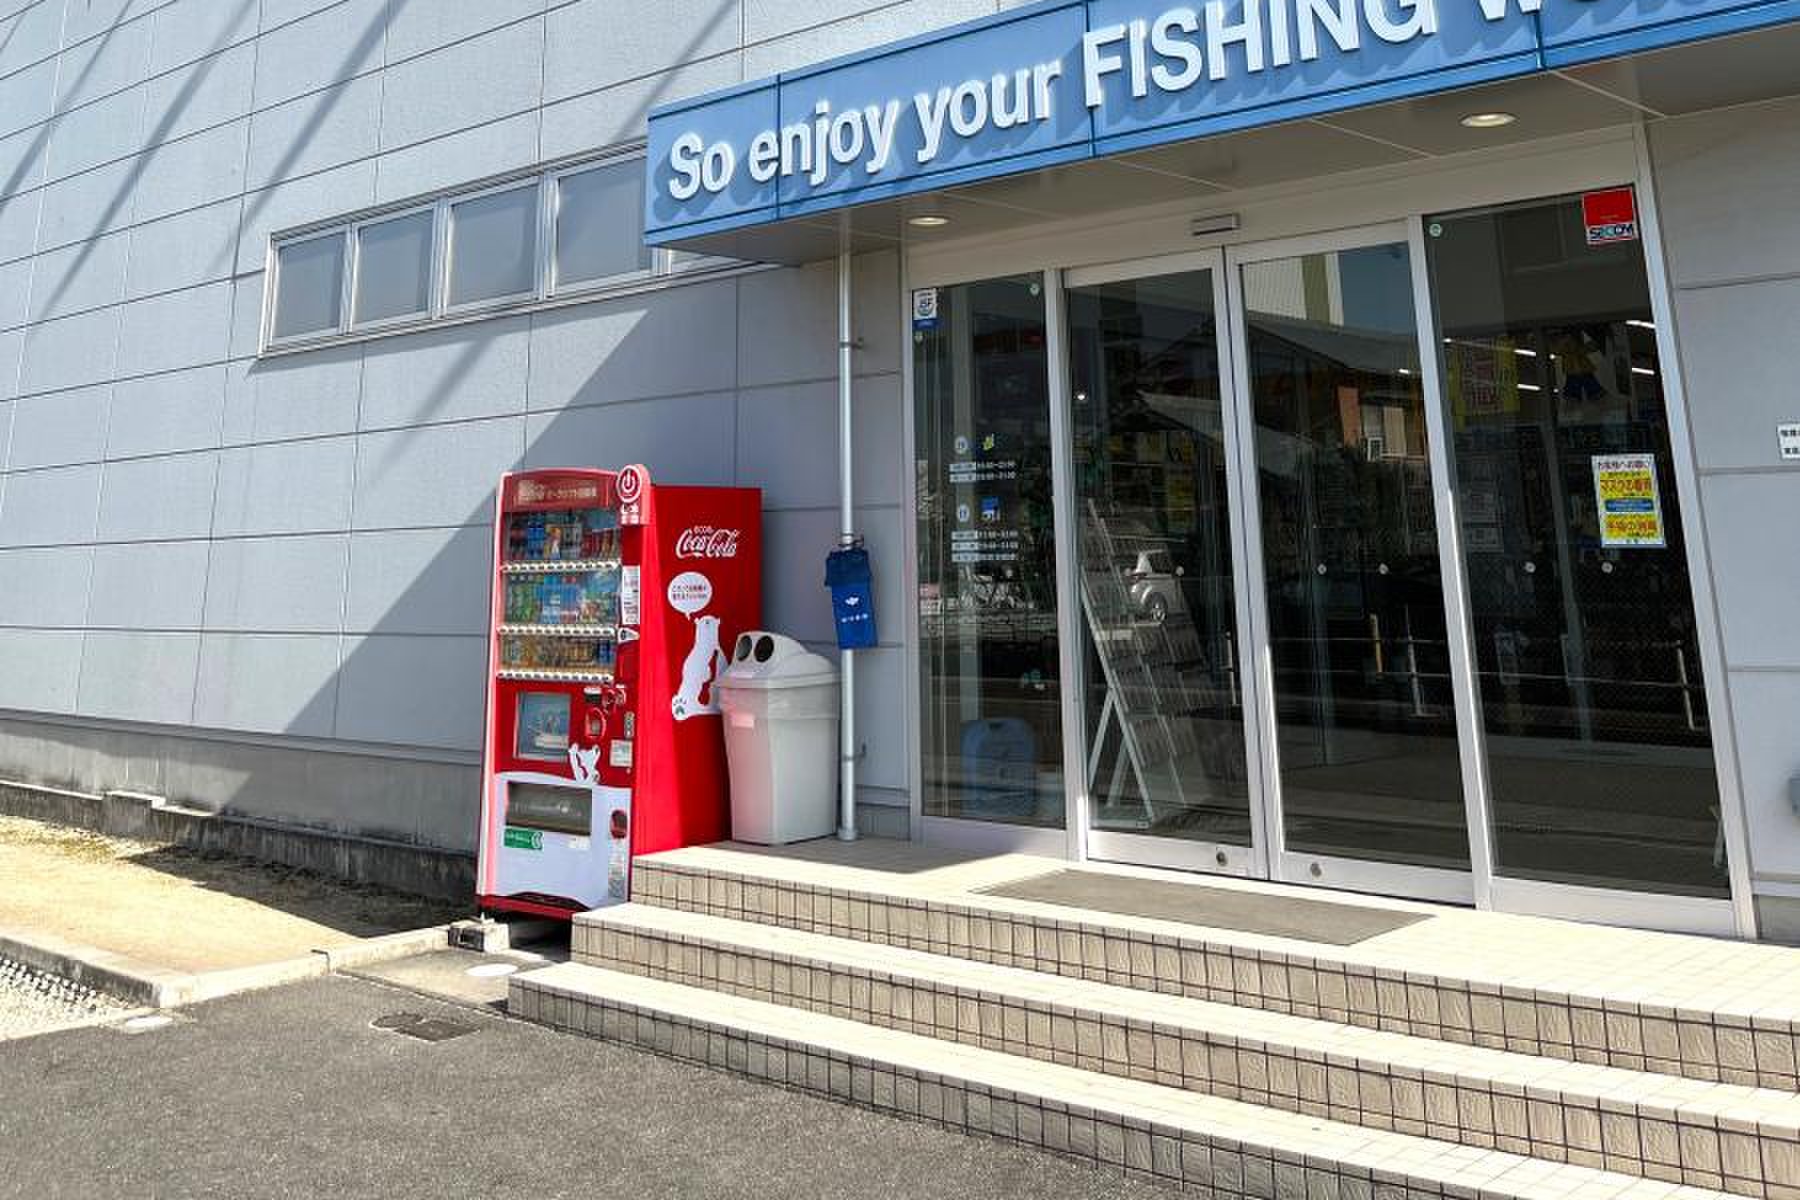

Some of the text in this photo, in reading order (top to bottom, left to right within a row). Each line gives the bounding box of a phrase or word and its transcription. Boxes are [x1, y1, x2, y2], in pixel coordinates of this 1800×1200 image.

[668, 132, 736, 202] So
[748, 99, 901, 186] enjoy
[914, 57, 1061, 164] your
[1589, 224, 1633, 239] SECOM
